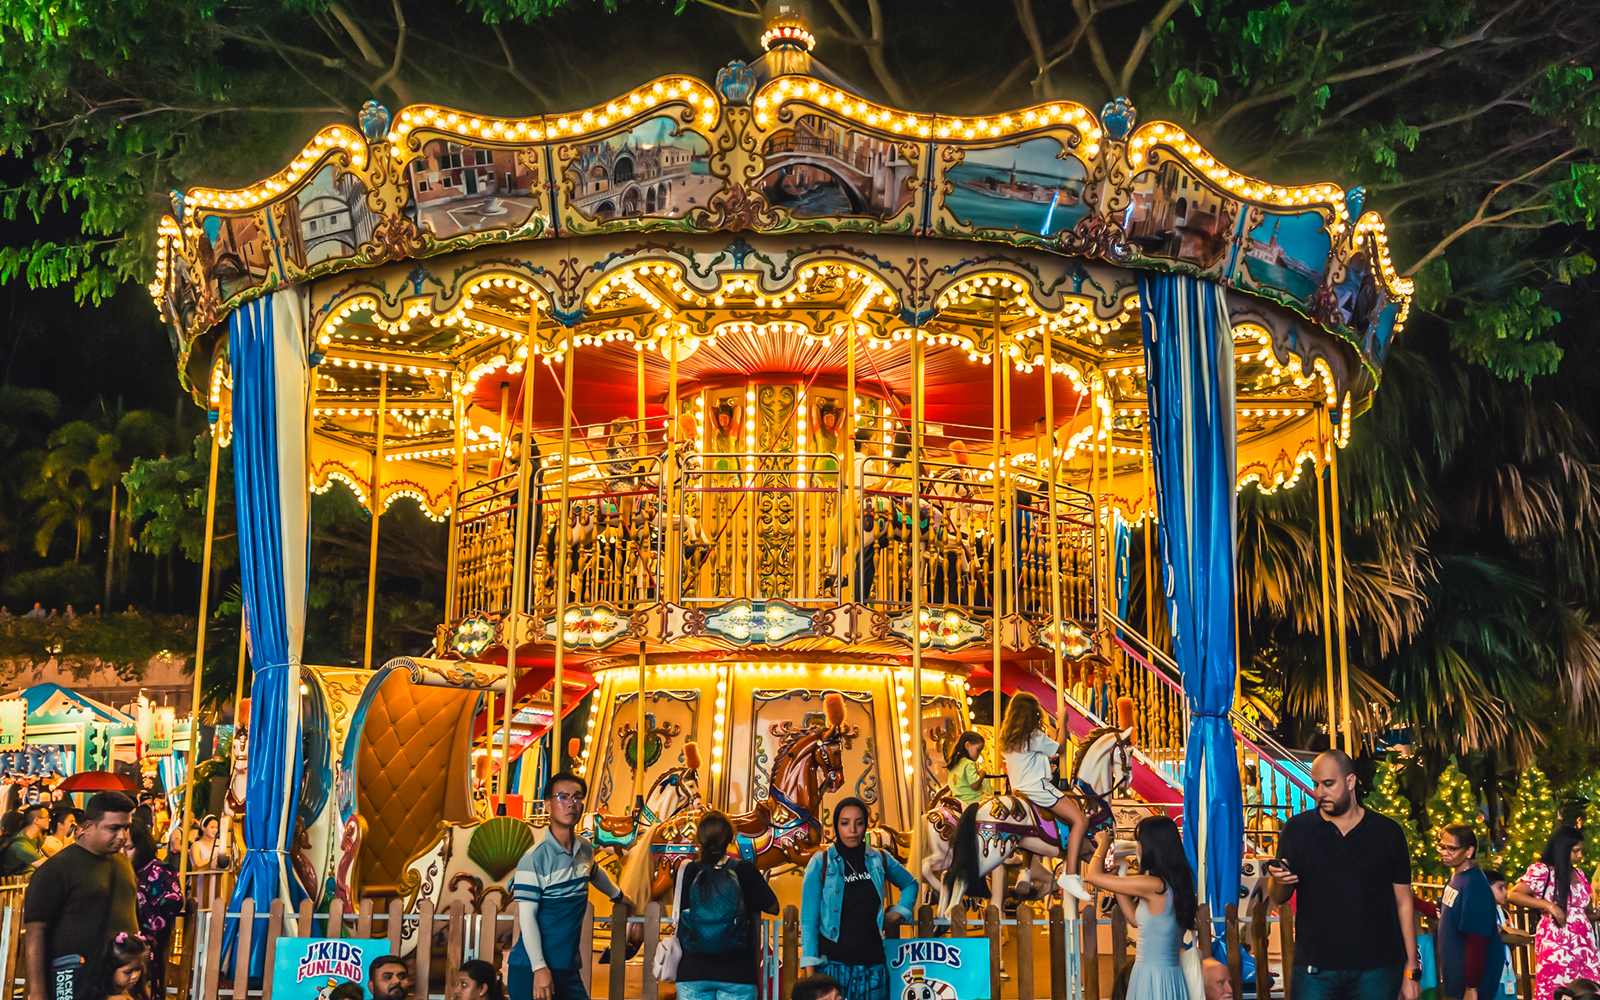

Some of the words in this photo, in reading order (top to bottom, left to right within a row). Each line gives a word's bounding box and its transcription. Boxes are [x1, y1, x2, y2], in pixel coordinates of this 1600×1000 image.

[149, 740, 169, 749] GOBLET
[300, 942, 362, 966] J'KIDS
[891, 942, 961, 967] J'KIDS
[297, 960, 361, 982] FUNLAND
